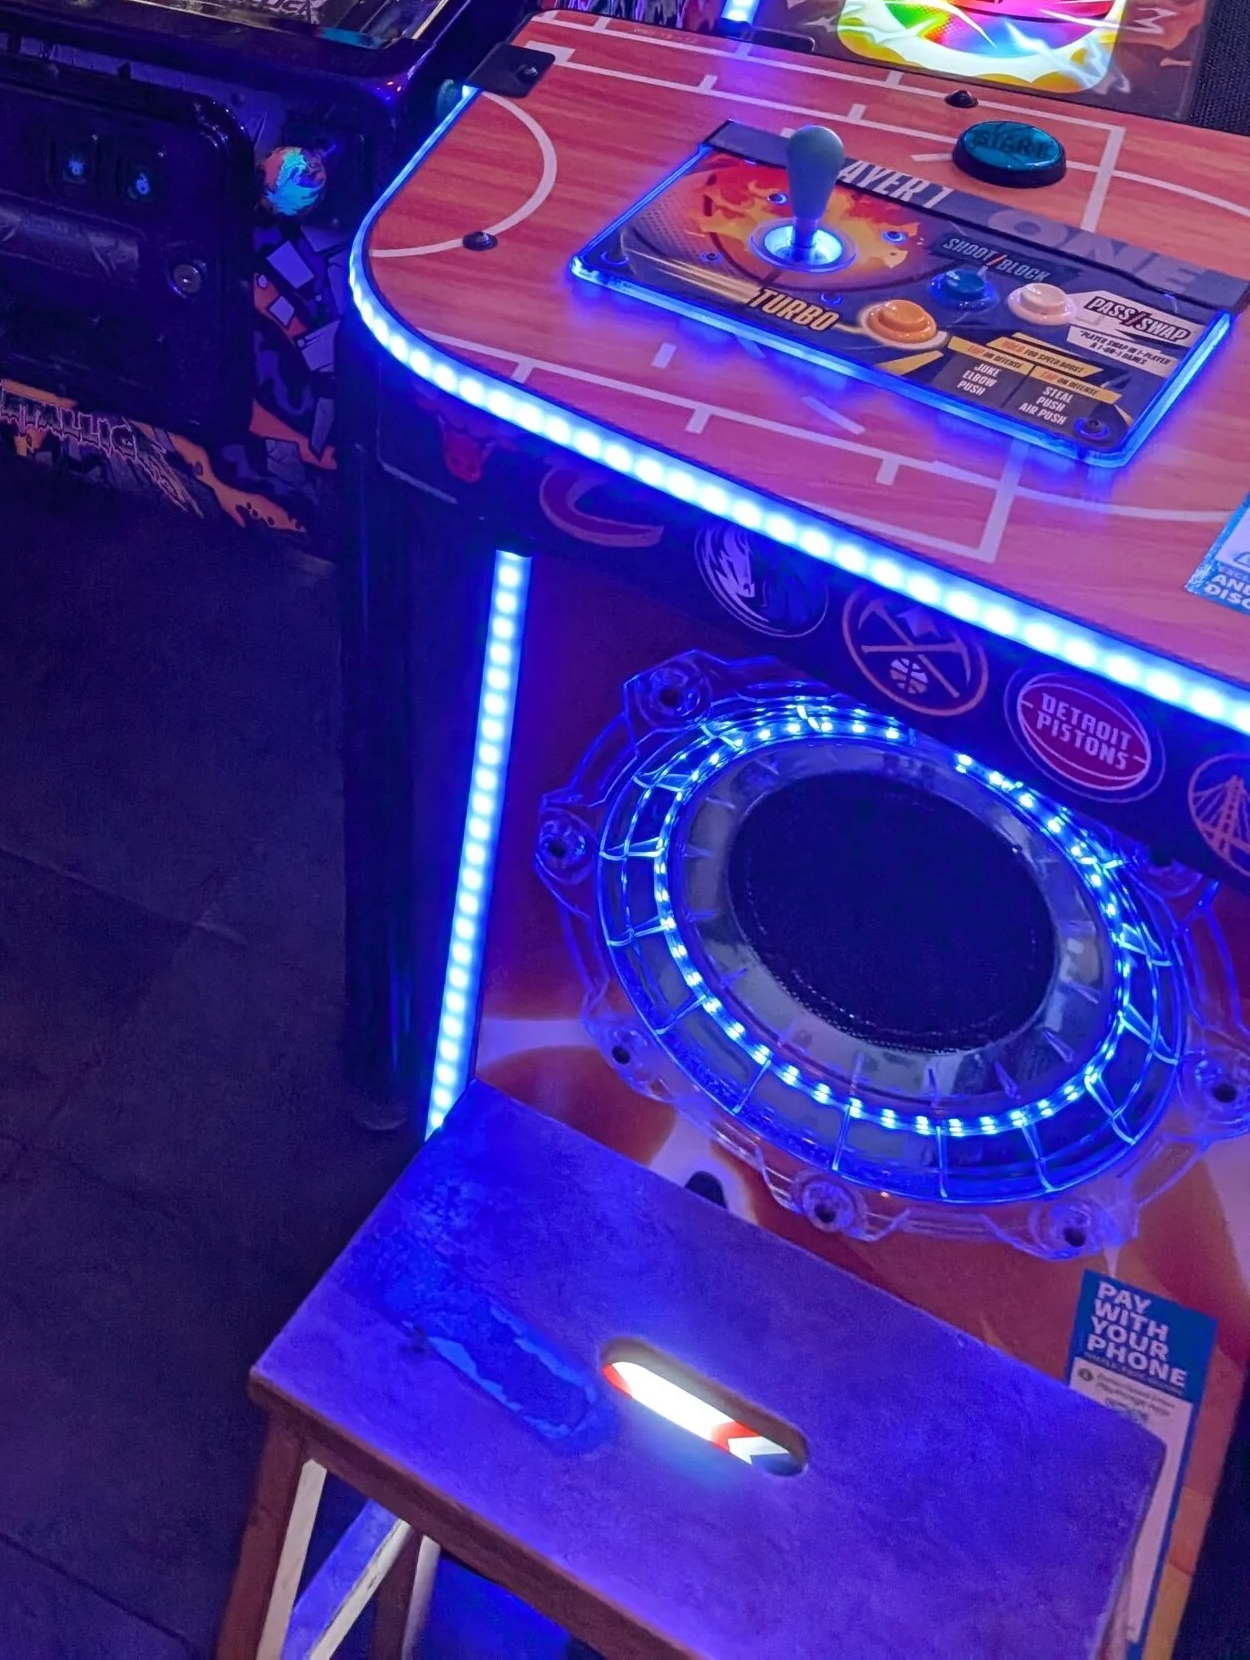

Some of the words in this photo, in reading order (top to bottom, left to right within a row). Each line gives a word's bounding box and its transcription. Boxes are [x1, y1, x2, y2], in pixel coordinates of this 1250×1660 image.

[837, 160, 931, 202] AYER
[943, 238, 1051, 282] SHOOT/BLOCK
[750, 288, 840, 331] TURBO
[1087, 296, 1191, 341] PASS/SWAP
[983, 350, 993, 359] ON
[993, 353, 1023, 369] OFFENSE
[1106, 337, 1129, 352] SWAP
[1129, 345, 1137, 354] IN
[974, 363, 1002, 377] JUKE
[1024, 349, 1038, 358] FOR
[1038, 352, 1062, 367] SPEED
[1062, 361, 1085, 374] BOOST
[957, 380, 987, 396] PUSH
[962, 370, 998, 388] ELBOW
[1058, 377, 1068, 386] ON
[1068, 379, 1099, 396] DEFENSE
[1036, 396, 1066, 412] PUSH
[1042, 386, 1074, 404] STEAL
[1019, 403, 1037, 416] AIR
[1038, 408, 1068, 426] PUSH
[1041, 692, 1132, 750] DETROIT
[1036, 710, 1130, 771] PISTONS
[1098, 1280, 1152, 1314] PAY
[1094, 1298, 1170, 1342] WITH
[1091, 1315, 1170, 1361] YOUR
[1087, 1333, 1189, 1388] PHONE
